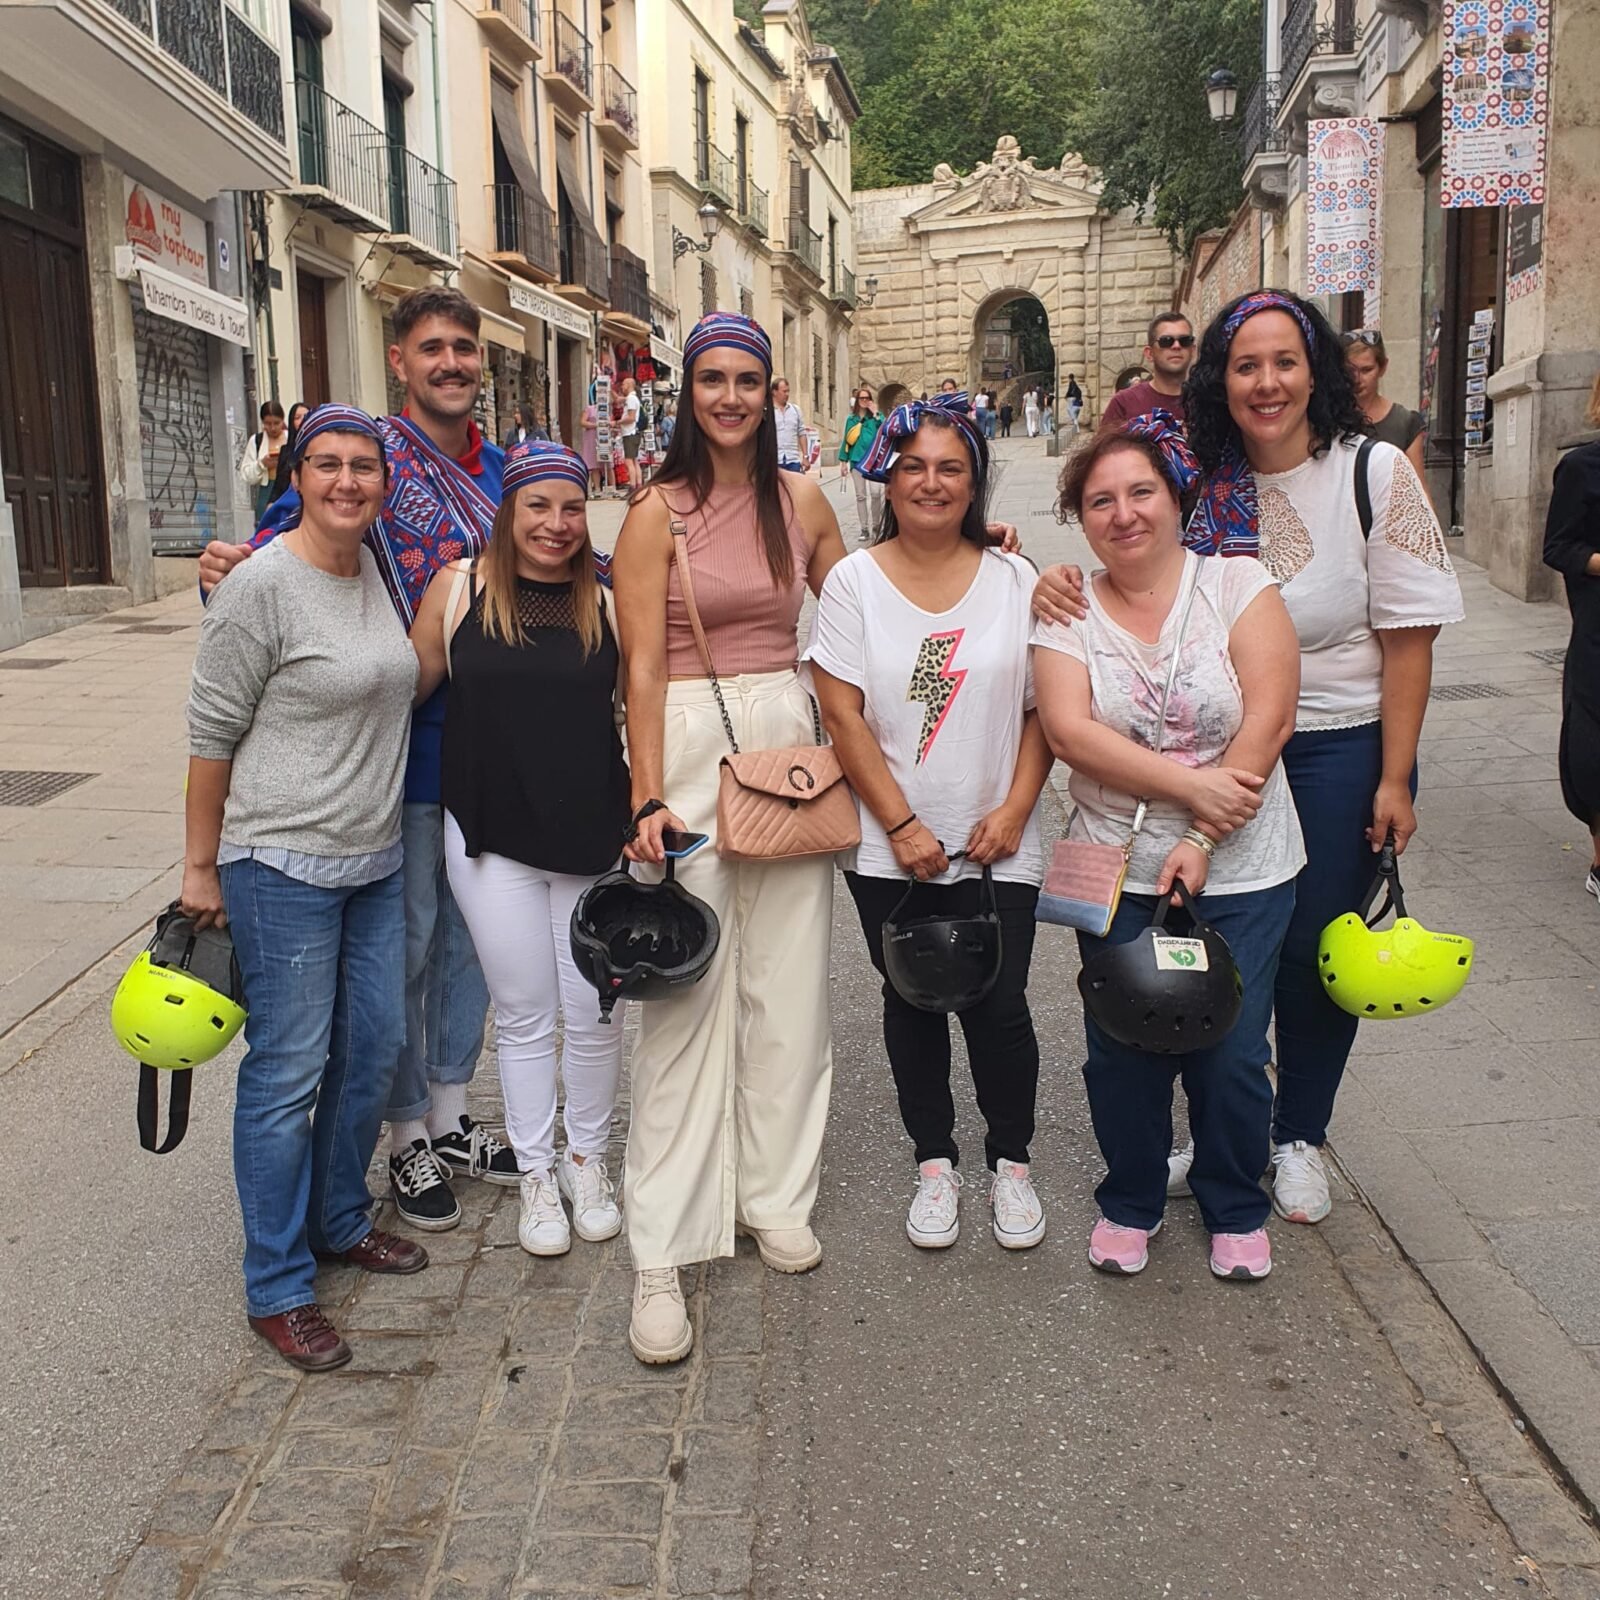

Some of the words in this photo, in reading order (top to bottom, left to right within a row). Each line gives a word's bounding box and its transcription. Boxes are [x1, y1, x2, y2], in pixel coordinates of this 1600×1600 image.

[160, 203, 181, 236] my
[163, 229, 204, 269] toptour
[146, 282, 187, 314] Alhambra
[190, 300, 216, 326] Tickets
